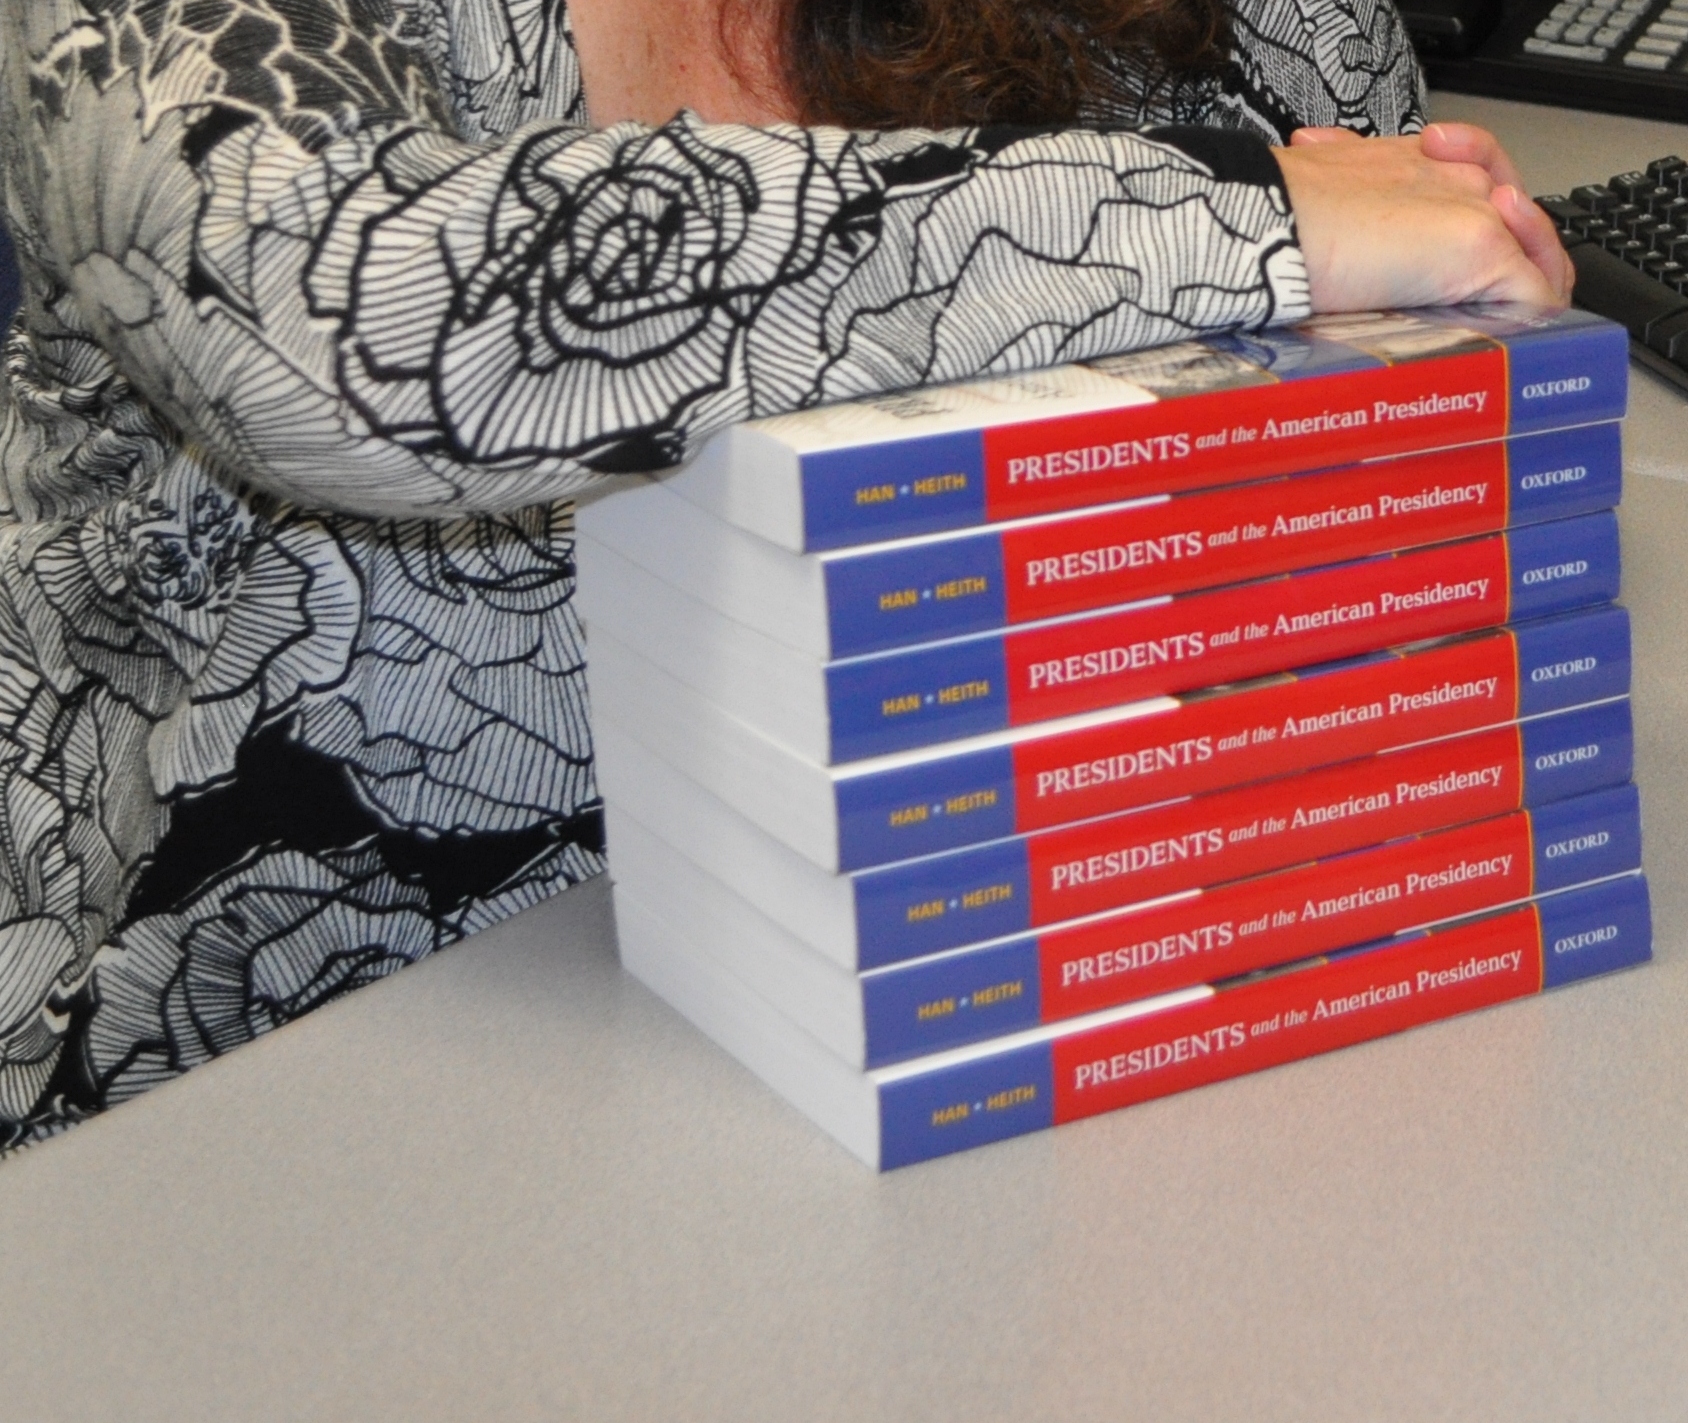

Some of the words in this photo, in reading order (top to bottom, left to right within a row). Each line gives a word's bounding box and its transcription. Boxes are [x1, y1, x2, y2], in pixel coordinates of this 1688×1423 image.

[855, 486, 894, 504] HAN
[914, 473, 966, 496] HEITH
[1008, 432, 1190, 484] PRESIDENTS
[1196, 430, 1227, 449] and
[1231, 426, 1257, 443] the
[1262, 406, 1368, 439] American
[1373, 390, 1487, 421] Presidency
[1522, 377, 1590, 399] OXFORD
[879, 590, 917, 611] HAN
[936, 577, 986, 600] HEITH
[1026, 531, 1201, 586] PRESIDENTS
[1208, 528, 1238, 547] and
[1242, 522, 1266, 540] the
[1272, 503, 1373, 537] American
[1378, 482, 1488, 517] Presidency
[1521, 466, 1586, 490] OXFORD
[882, 695, 919, 715] HAN
[938, 681, 989, 704] HEITH
[1029, 633, 1204, 688] PRESIDENTS
[1210, 628, 1240, 648] and
[1244, 623, 1268, 640] the
[1273, 602, 1374, 636] American
[1380, 578, 1489, 614] Presidency
[1522, 560, 1588, 585] OXFORD
[889, 805, 928, 827] HAN
[946, 791, 997, 814] HEITH
[1036, 737, 1211, 797] PRESIDENTS
[1218, 731, 1248, 752] and
[1252, 726, 1276, 743] the
[1281, 703, 1383, 738] American
[1388, 677, 1498, 714] Presidency
[1531, 657, 1596, 682] OXFORD
[908, 900, 944, 922] HAN
[962, 885, 1012, 909] HEITH
[1050, 828, 1223, 890] PRESIDENTS
[1228, 823, 1258, 843] and
[1262, 817, 1286, 835] the
[1291, 793, 1389, 829] American
[1396, 765, 1502, 804] Presidency
[1535, 744, 1599, 770] OXFORD
[918, 997, 954, 1020] HAN
[973, 981, 1022, 1006] HEITH
[1061, 922, 1234, 986] PRESIDENTS
[1238, 916, 1268, 936] and
[1272, 910, 1296, 929] the
[1301, 885, 1399, 921] American
[1406, 853, 1512, 895] Presidency
[1545, 832, 1609, 858] OXFORD
[932, 1102, 969, 1126] HAN
[987, 1086, 1035, 1110] HEITH
[1074, 1023, 1245, 1089] PRESIDENTS
[1250, 1017, 1279, 1037] and
[1284, 1010, 1308, 1029] the
[1313, 984, 1410, 1021] American
[1416, 949, 1522, 993] Presidency
[1554, 926, 1618, 953] OXFORD
